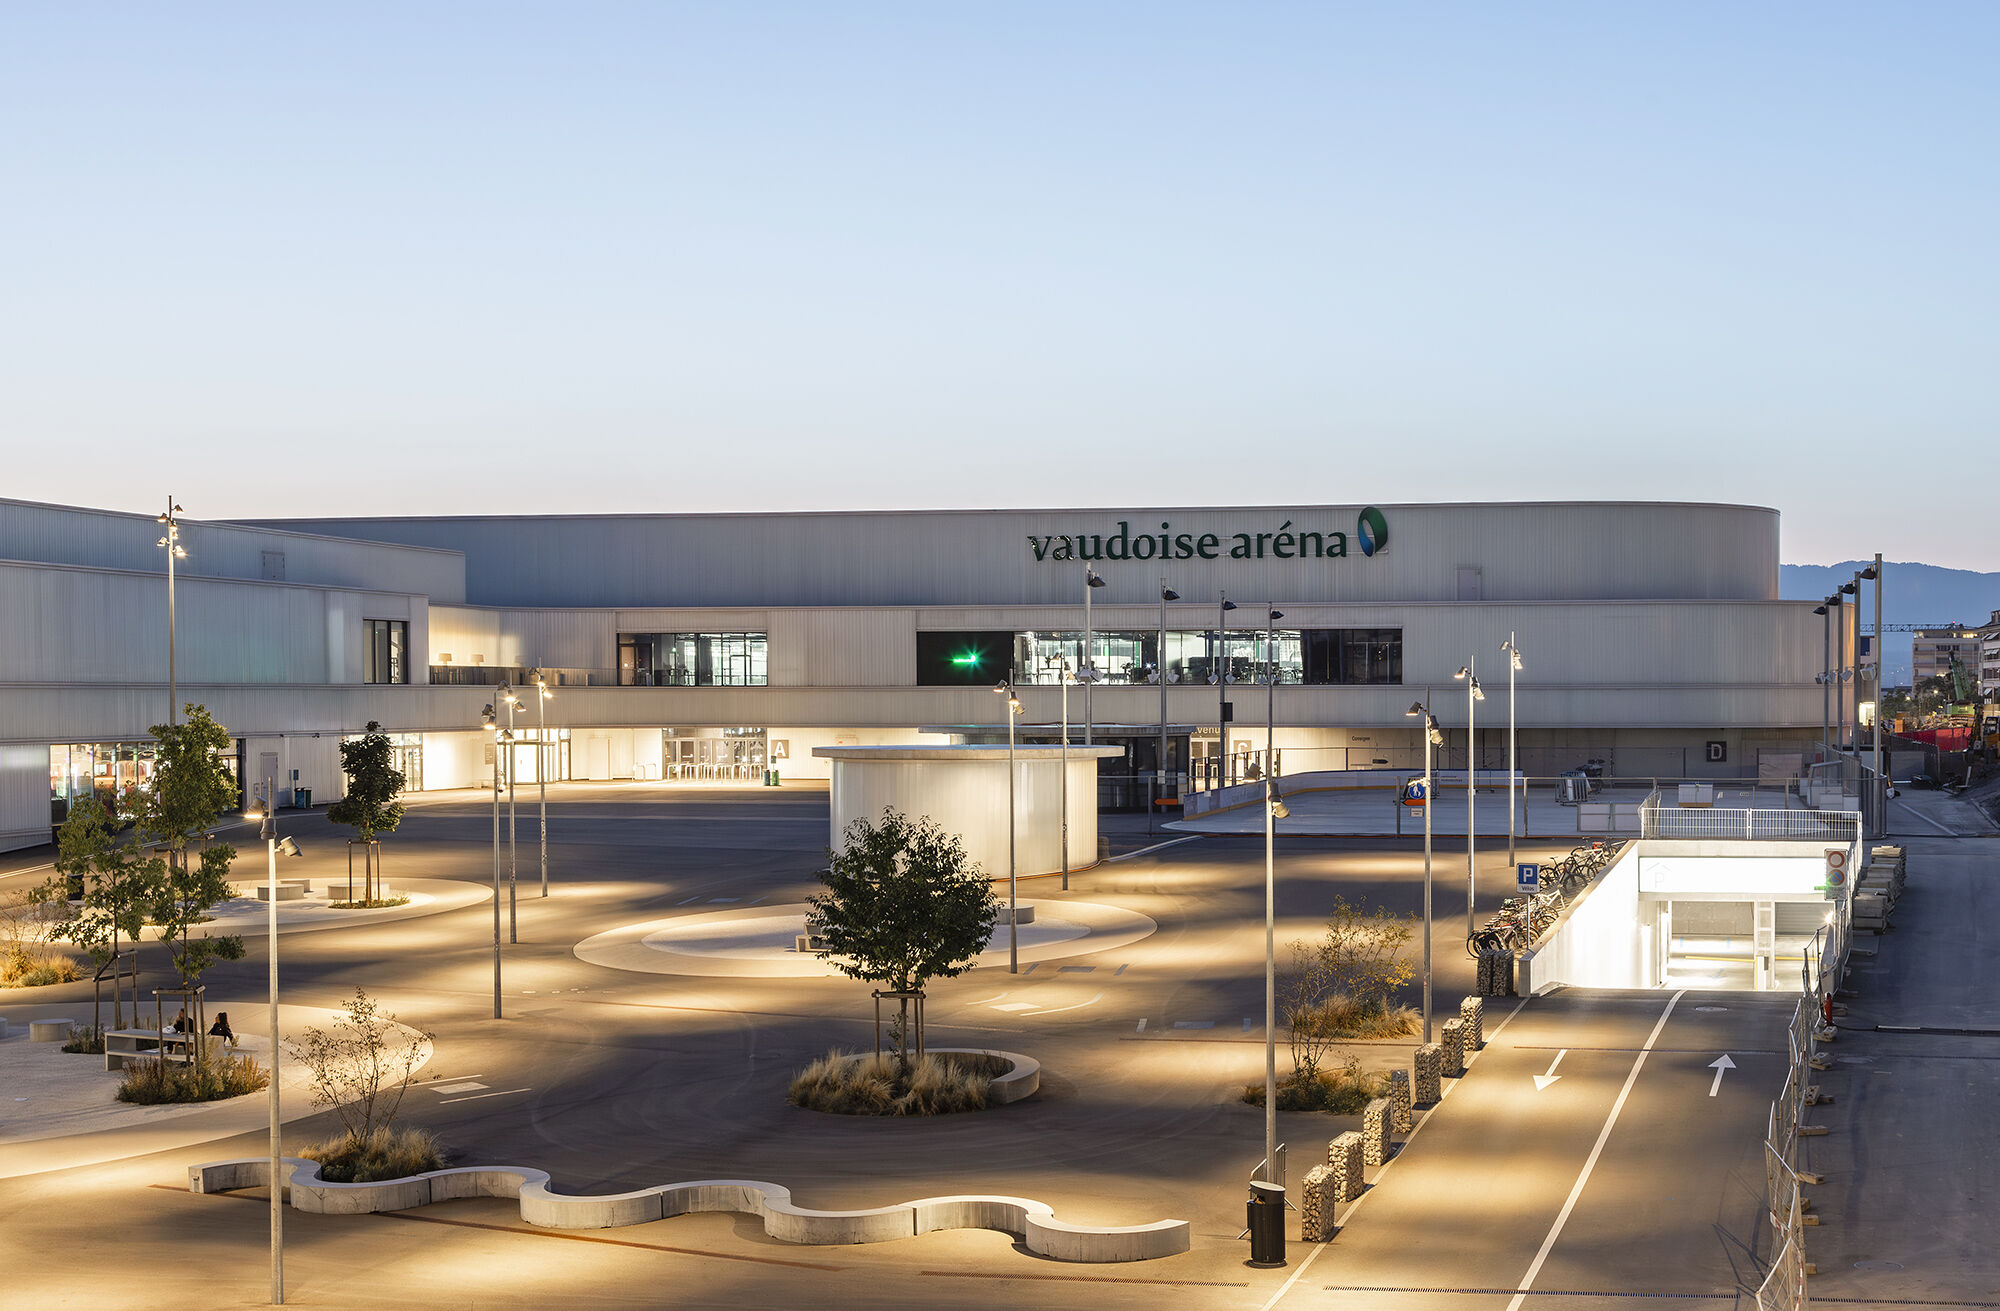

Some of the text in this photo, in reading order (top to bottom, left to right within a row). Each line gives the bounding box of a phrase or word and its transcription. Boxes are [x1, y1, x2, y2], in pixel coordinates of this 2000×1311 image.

[1027, 519, 1348, 562] vaudoise aréna
[774, 741, 786, 757] A
[1711, 743, 1723, 760] D
[1523, 867, 1533, 883] P
[1654, 871, 1665, 889] P
